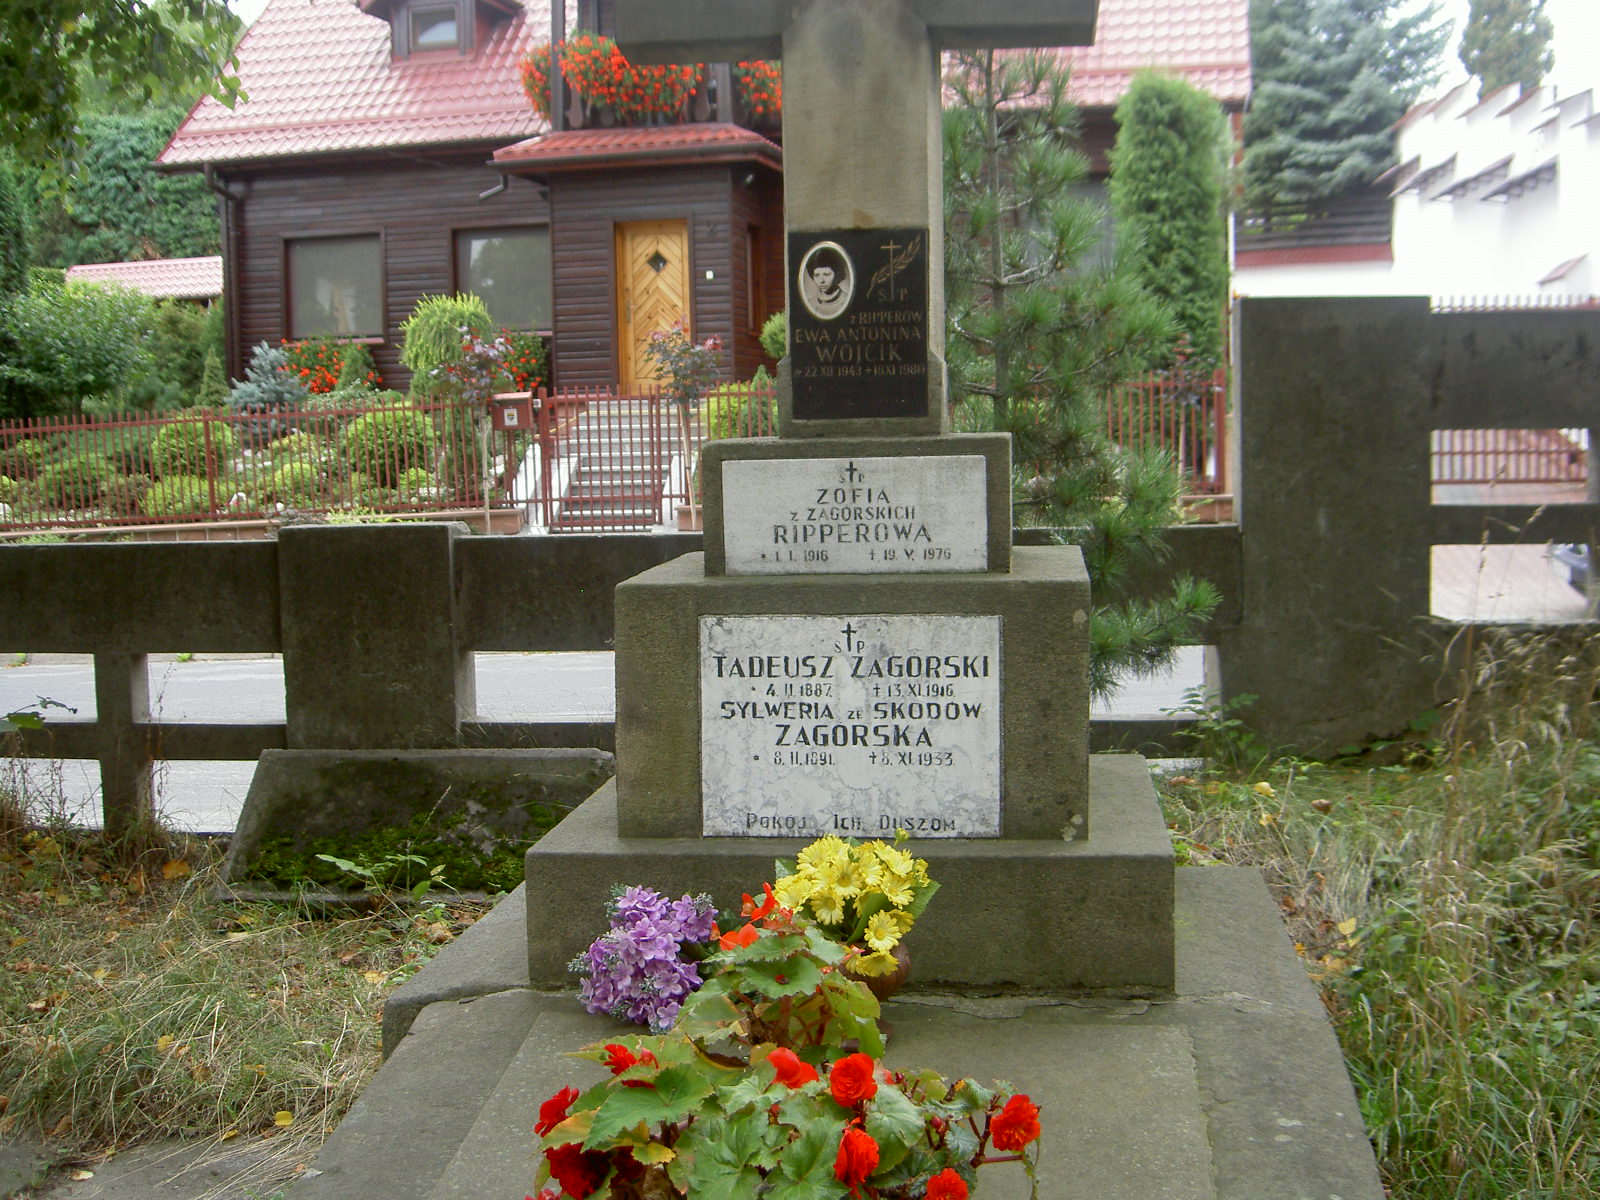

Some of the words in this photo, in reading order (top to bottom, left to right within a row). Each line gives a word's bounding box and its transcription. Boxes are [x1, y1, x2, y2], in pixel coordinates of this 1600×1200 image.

[795, 328, 831, 344] EWA
[836, 326, 921, 342] ANTONINA
[816, 487, 890, 504] ZOFIA
[773, 522, 932, 544] RIPPEROWA
[923, 547, 952, 560] 1976
[712, 655, 834, 678] TADEUSZ
[720, 701, 834, 720] SYLWERIA
